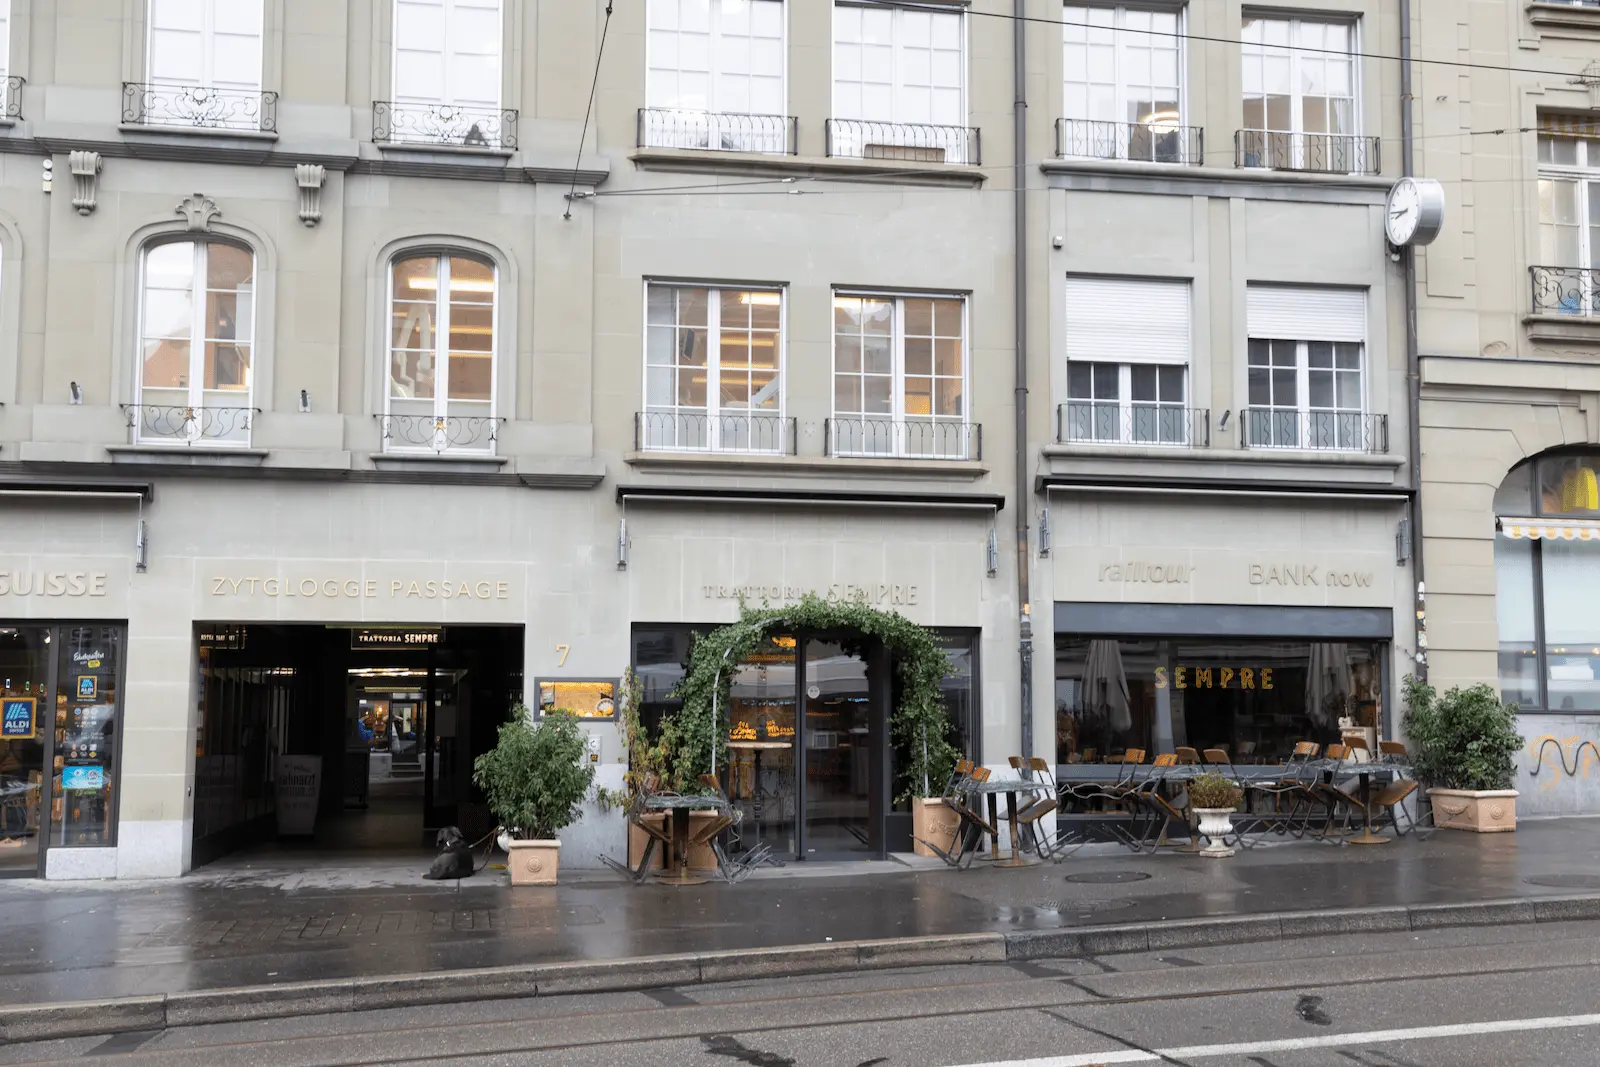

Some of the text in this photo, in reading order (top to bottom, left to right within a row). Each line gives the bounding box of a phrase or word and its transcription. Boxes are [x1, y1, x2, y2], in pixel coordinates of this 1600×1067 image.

[1248, 563, 1373, 588] BANK now
[212, 577, 508, 599] ZYTGLOGGE PASSAGE
[404, 633, 439, 643] SEMPRE
[556, 644, 570, 667] 7
[1154, 666, 1274, 690] SEMPRE
[4, 720, 30, 729] ALDI
